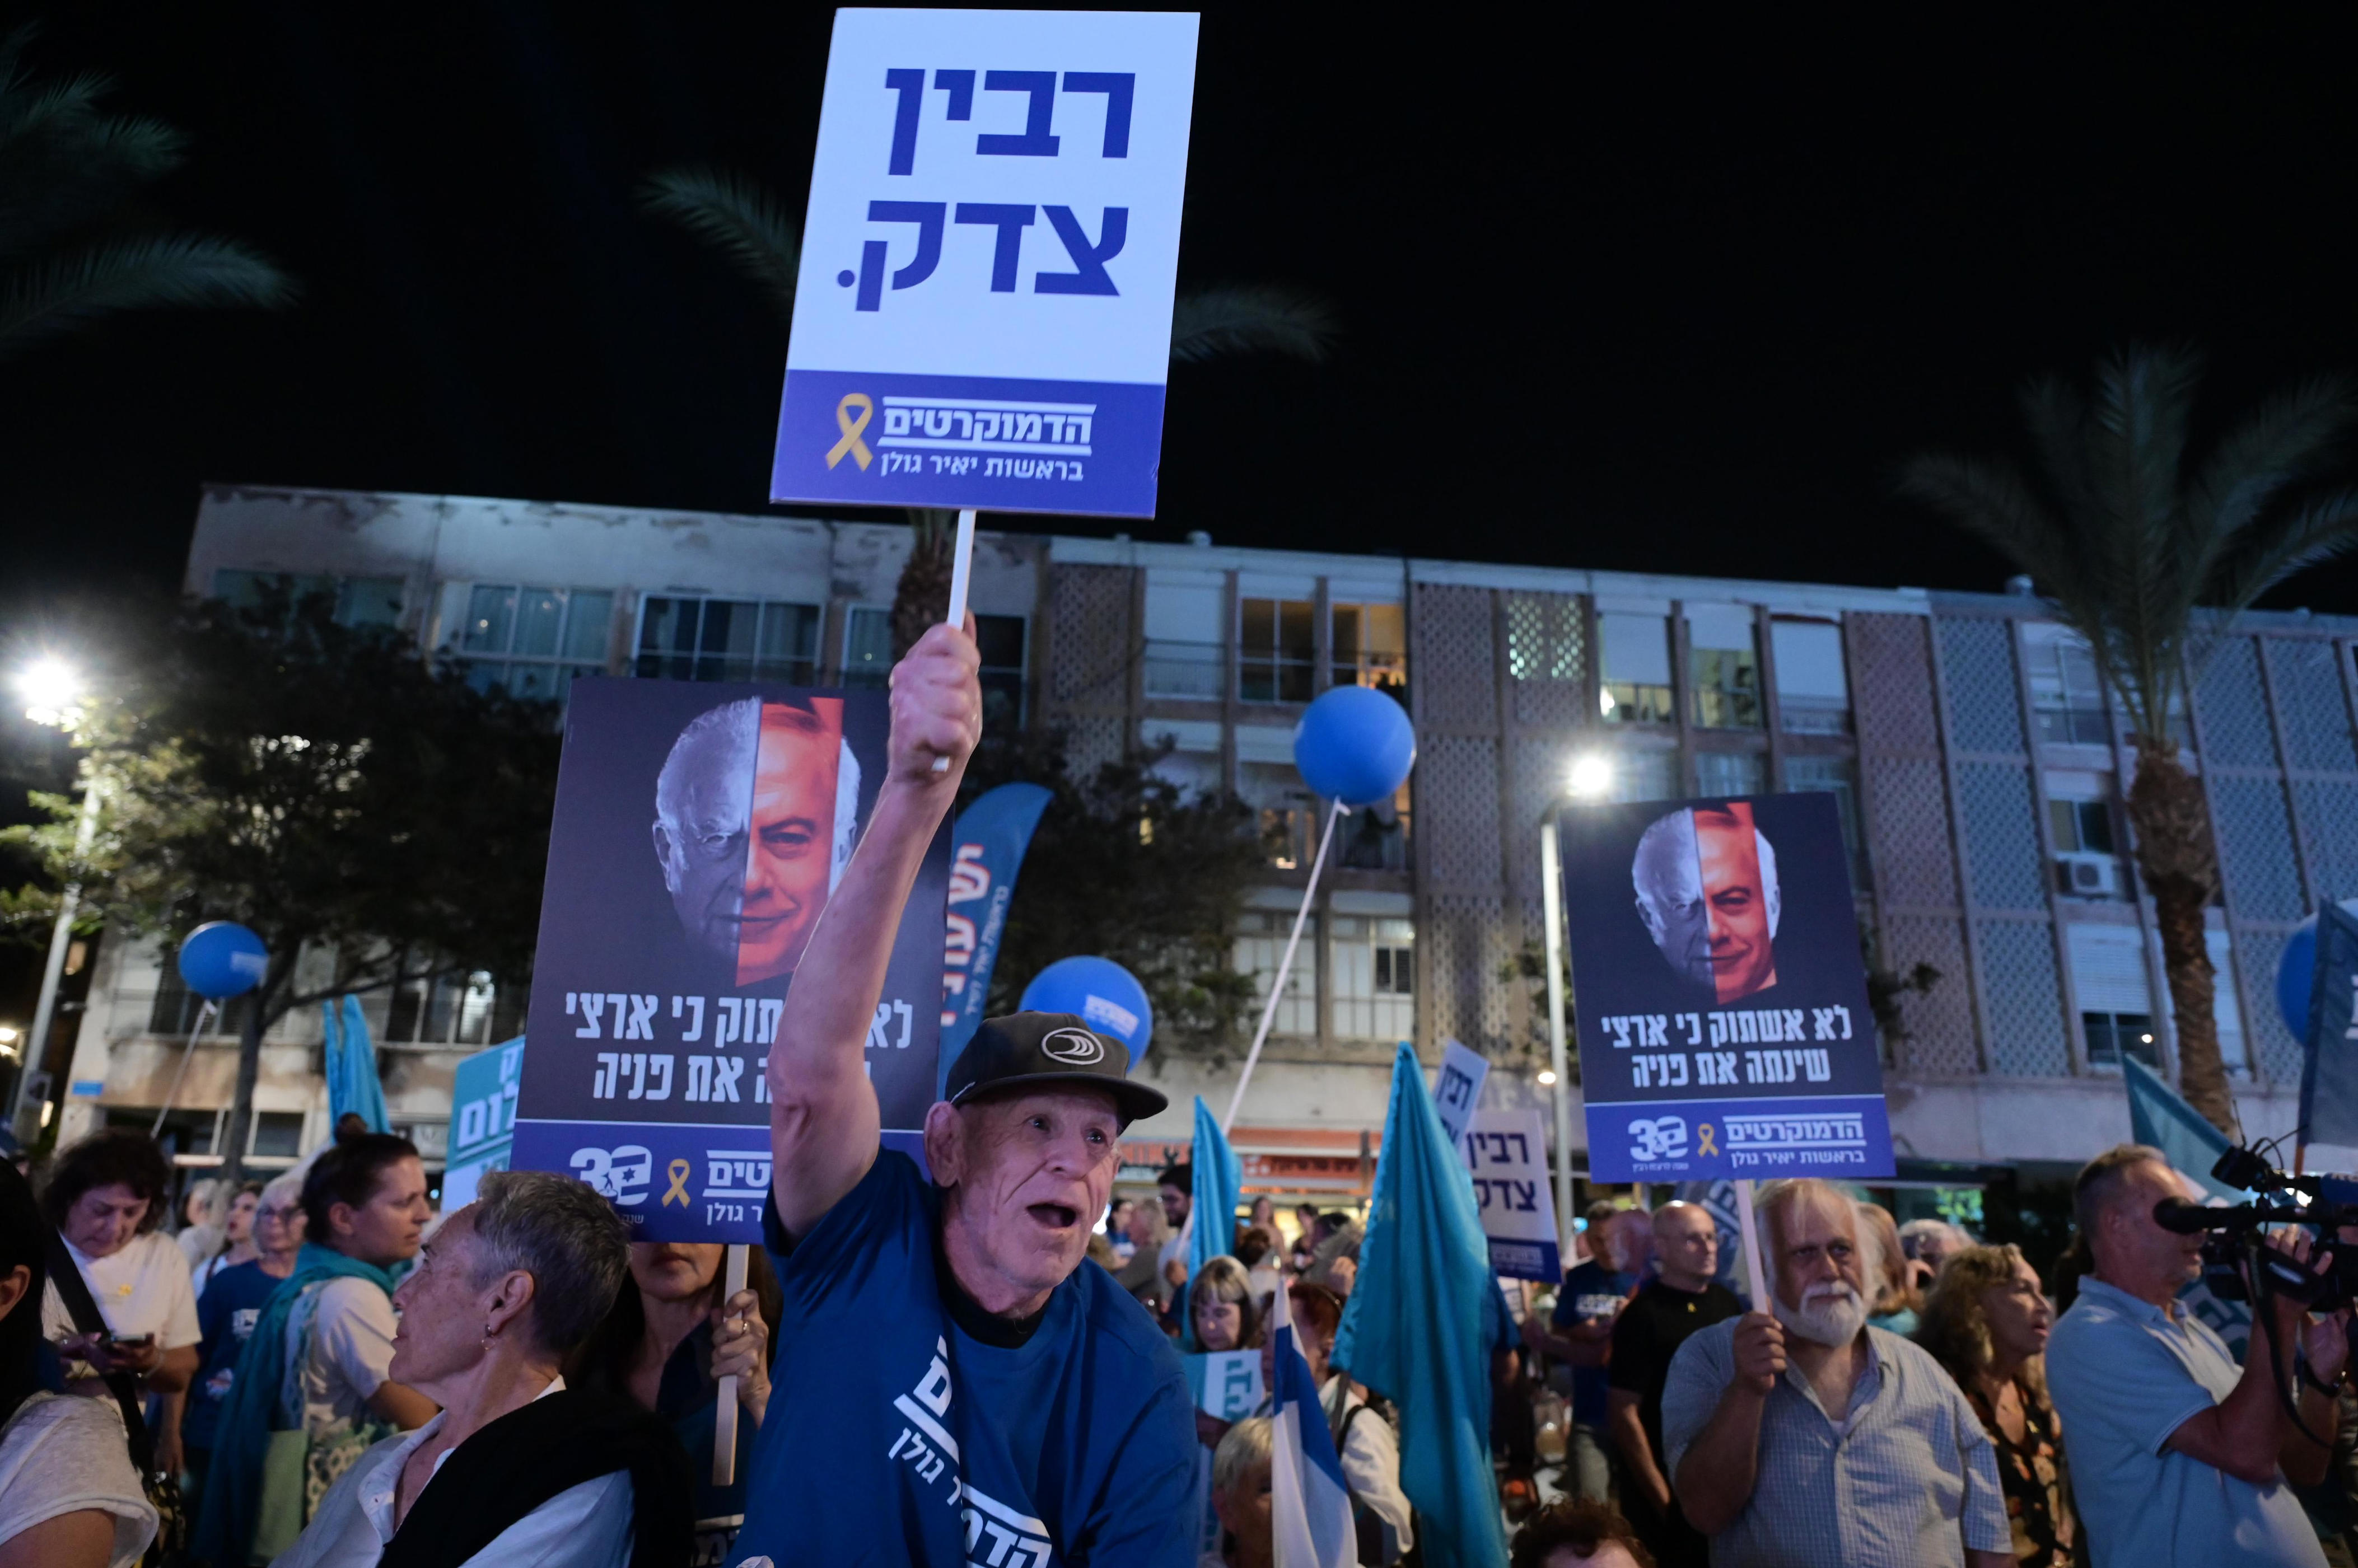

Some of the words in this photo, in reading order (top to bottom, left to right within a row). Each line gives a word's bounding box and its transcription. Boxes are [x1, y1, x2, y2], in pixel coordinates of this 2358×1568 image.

[885, 68, 1136, 176] רבין
[837, 200, 1129, 312] צדק.
[883, 408, 1092, 445] הדמוקרטים
[880, 451, 923, 478] גולן
[929, 454, 978, 476] יאיר
[983, 457, 1084, 481] בראשות
[565, 992, 659, 1041] ארצי
[671, 995, 706, 1042] כי
[715, 996, 784, 1049] תוק
[864, 999, 913, 1049] לא
[1600, 1014, 1669, 1049] ארצי
[1675, 1012, 1702, 1046] כי
[1707, 1009, 1807, 1049] אשתוק
[1811, 1004, 1853, 1041] לא
[592, 1052, 675, 1101] פניה
[684, 1055, 744, 1103] את
[1631, 1052, 1689, 1088] פניה
[1694, 1051, 1739, 1086] את
[1744, 1049, 1832, 1085] שינתה
[1725, 1119, 1865, 1143] הדמוקרטים
[1467, 1132, 1529, 1169] רבין
[1731, 1150, 1759, 1169] גולן
[1763, 1151, 1794, 1165] יאיר
[1799, 1150, 1866, 1165] בראשות
[706, 1202, 744, 1226] גולן
[888, 1426, 945, 1486] גולן
